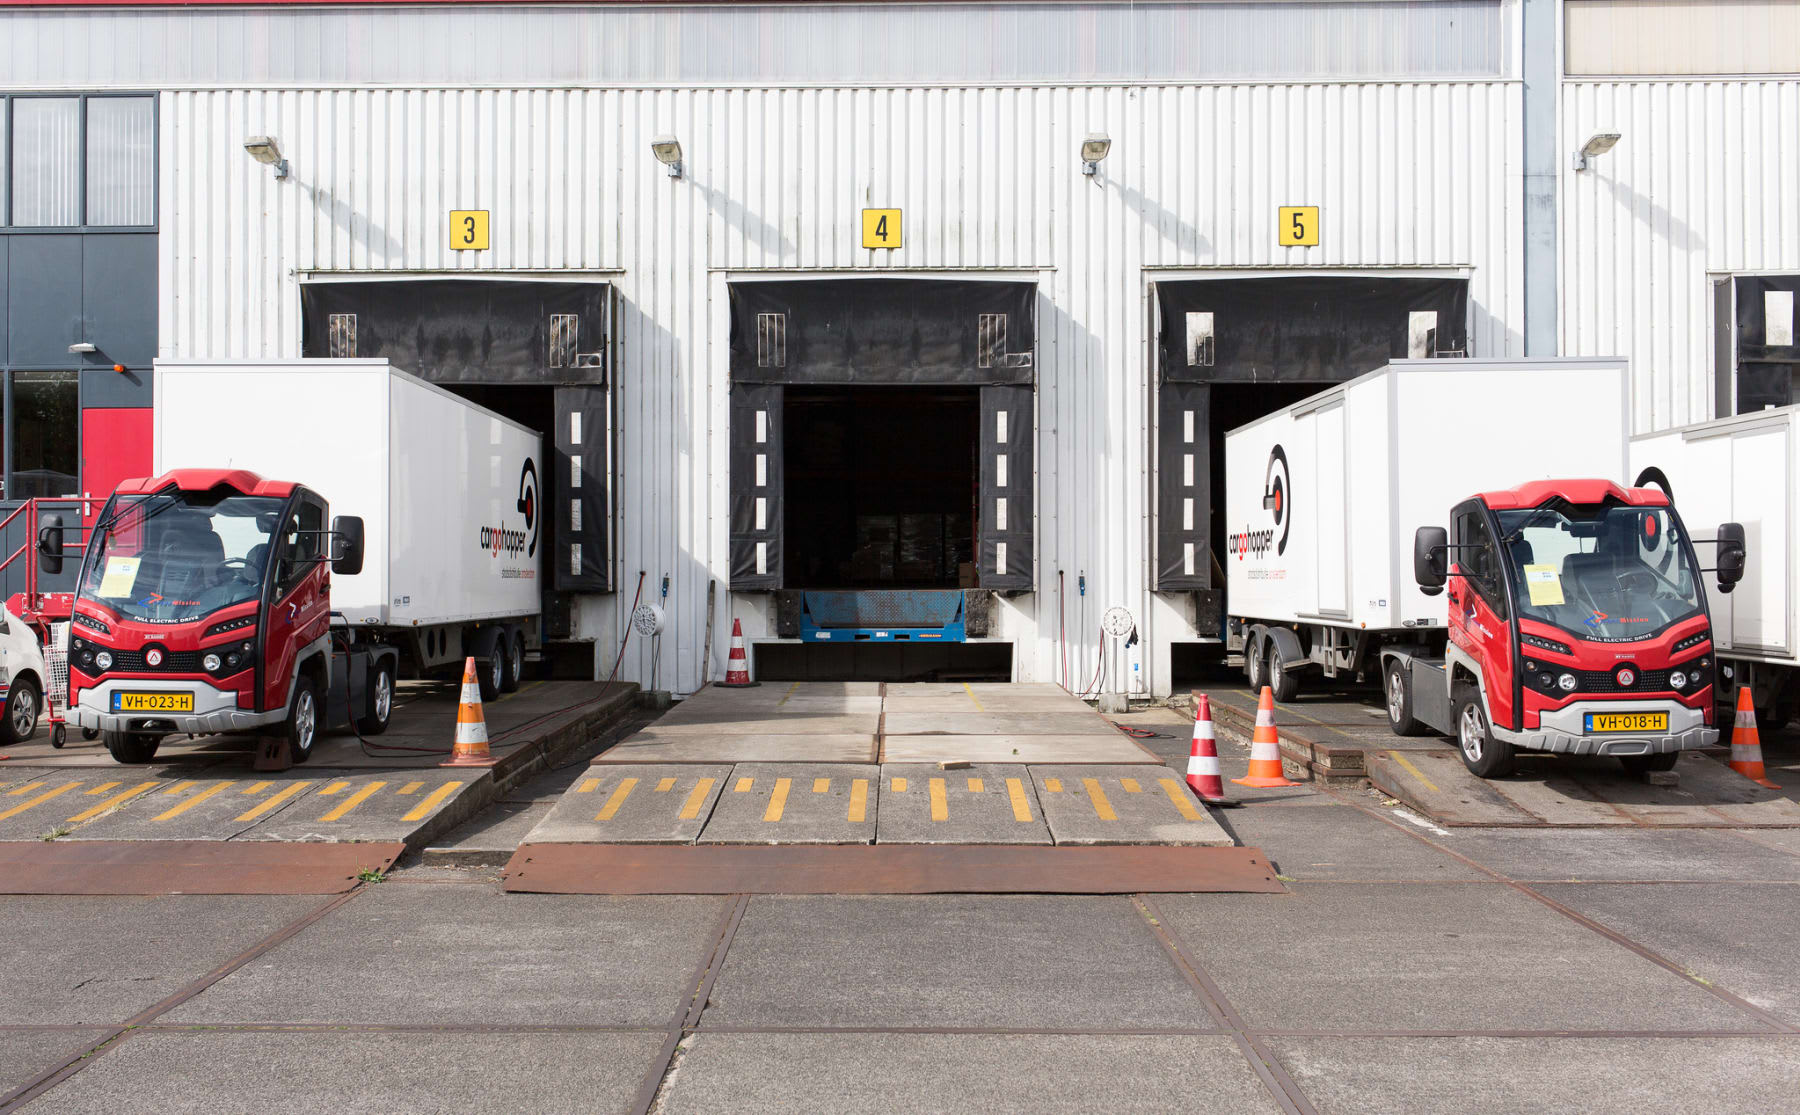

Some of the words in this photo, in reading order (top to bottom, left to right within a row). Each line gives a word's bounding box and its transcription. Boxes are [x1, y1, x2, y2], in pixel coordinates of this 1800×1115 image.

[464, 216, 475, 244] 3
[875, 215, 888, 242] 4
[1293, 213, 1304, 240] 5
[480, 520, 526, 559] cargohopper
[1229, 523, 1273, 560] cargohopper
[134, 615, 149, 623] FULL
[179, 615, 199, 623] DRIVE
[1634, 633, 1653, 641] DRIVE
[126, 696, 189, 708] VH-023-H
[1599, 716, 1662, 728] VH-018-H
